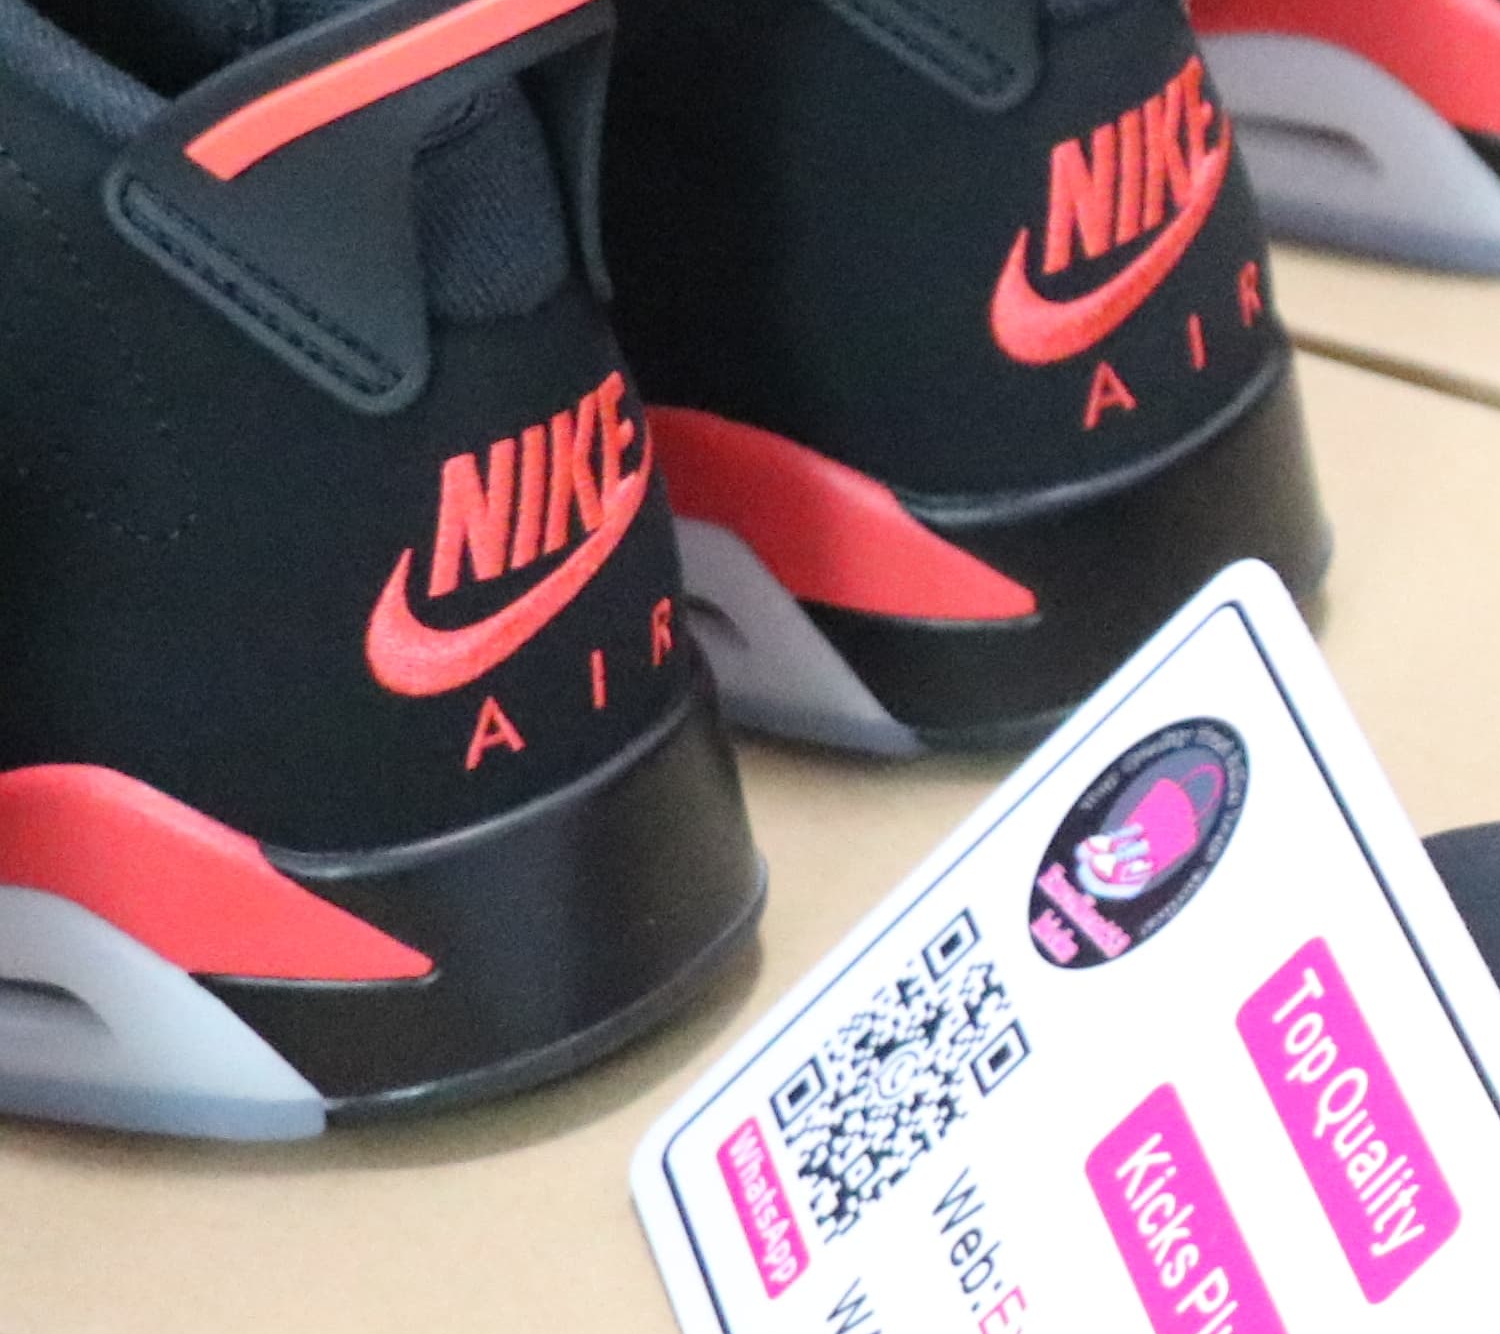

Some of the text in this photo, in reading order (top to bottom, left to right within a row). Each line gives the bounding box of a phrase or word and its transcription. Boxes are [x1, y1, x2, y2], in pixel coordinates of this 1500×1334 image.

[1043, 55, 1213, 275] NIKE
[1083, 261, 1263, 430] AIR
[428, 370, 635, 599] NIKE
[465, 596, 673, 771] AIR
[1271, 967, 1426, 1258] Top Quality
[729, 1128, 798, 1284] WhatsApp
[1115, 1131, 1200, 1289] Kicks
